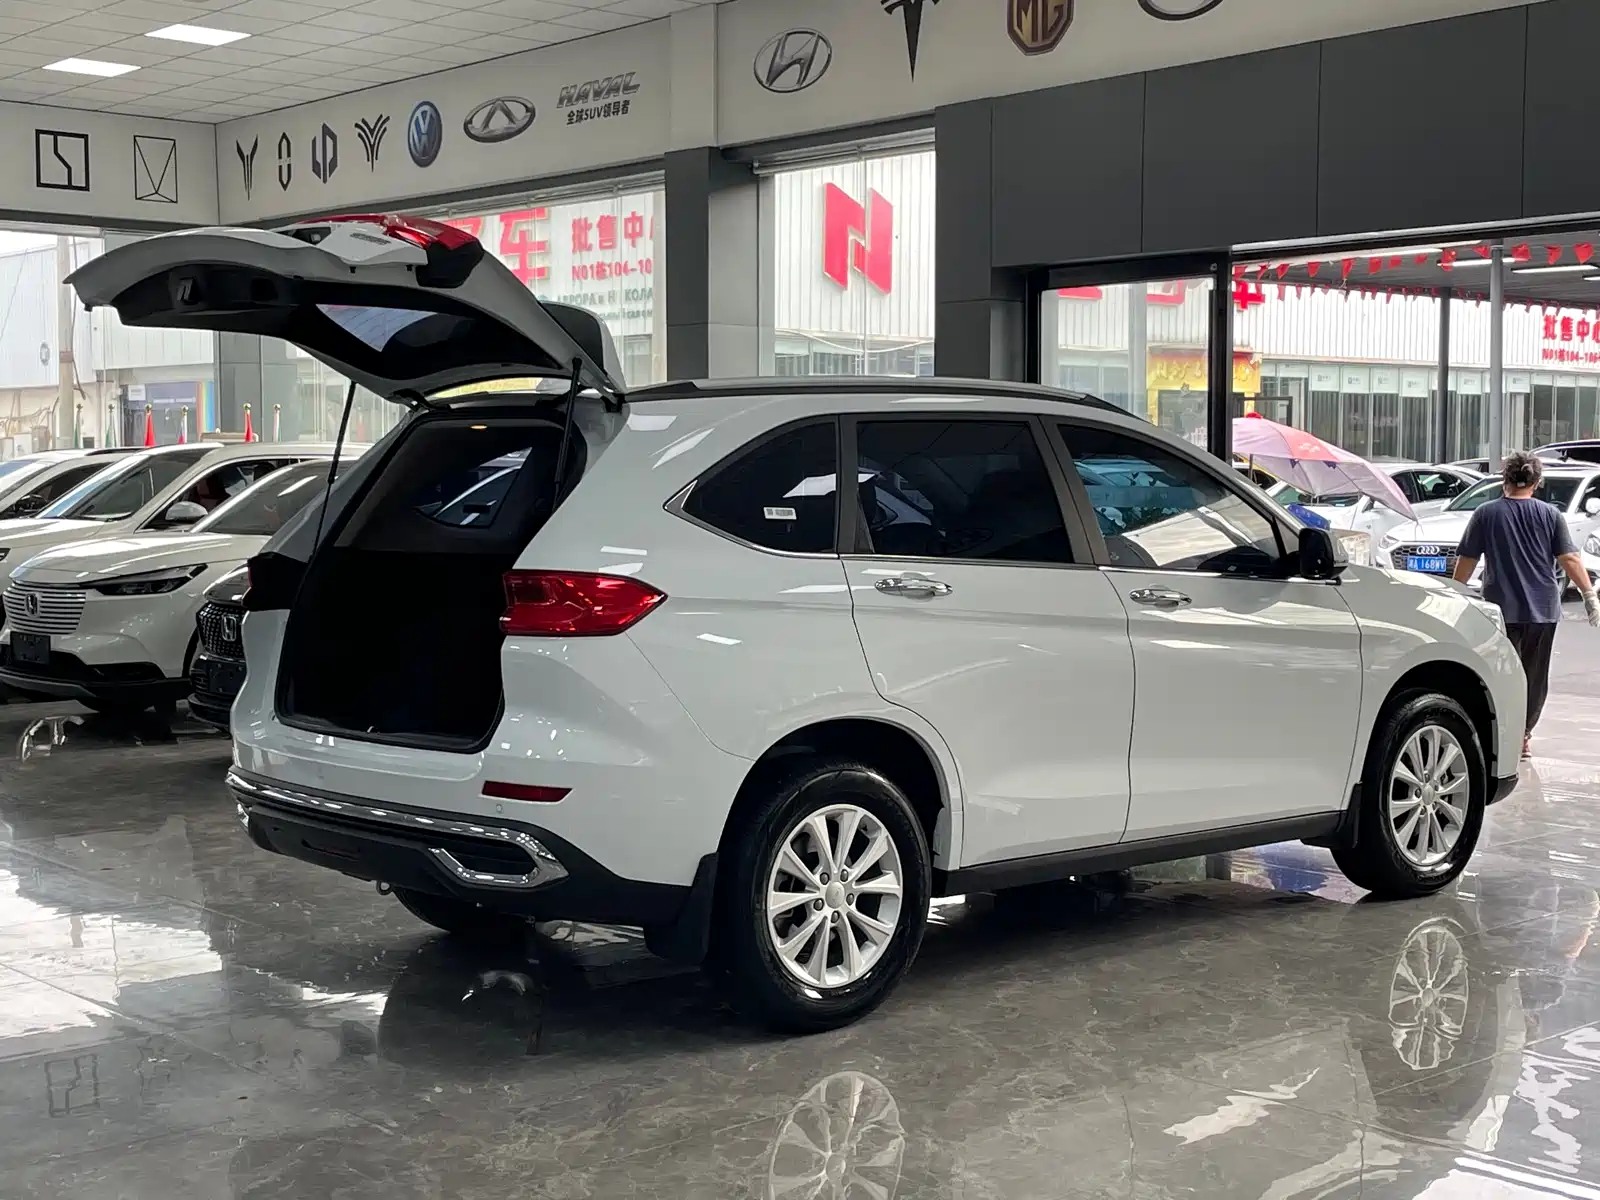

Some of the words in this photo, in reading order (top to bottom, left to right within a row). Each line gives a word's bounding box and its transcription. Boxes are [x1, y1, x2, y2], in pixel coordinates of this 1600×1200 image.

[557, 72, 641, 109] HAVAL
[566, 99, 630, 125] 全球SUV领导者
[572, 211, 653, 254] 批售中
